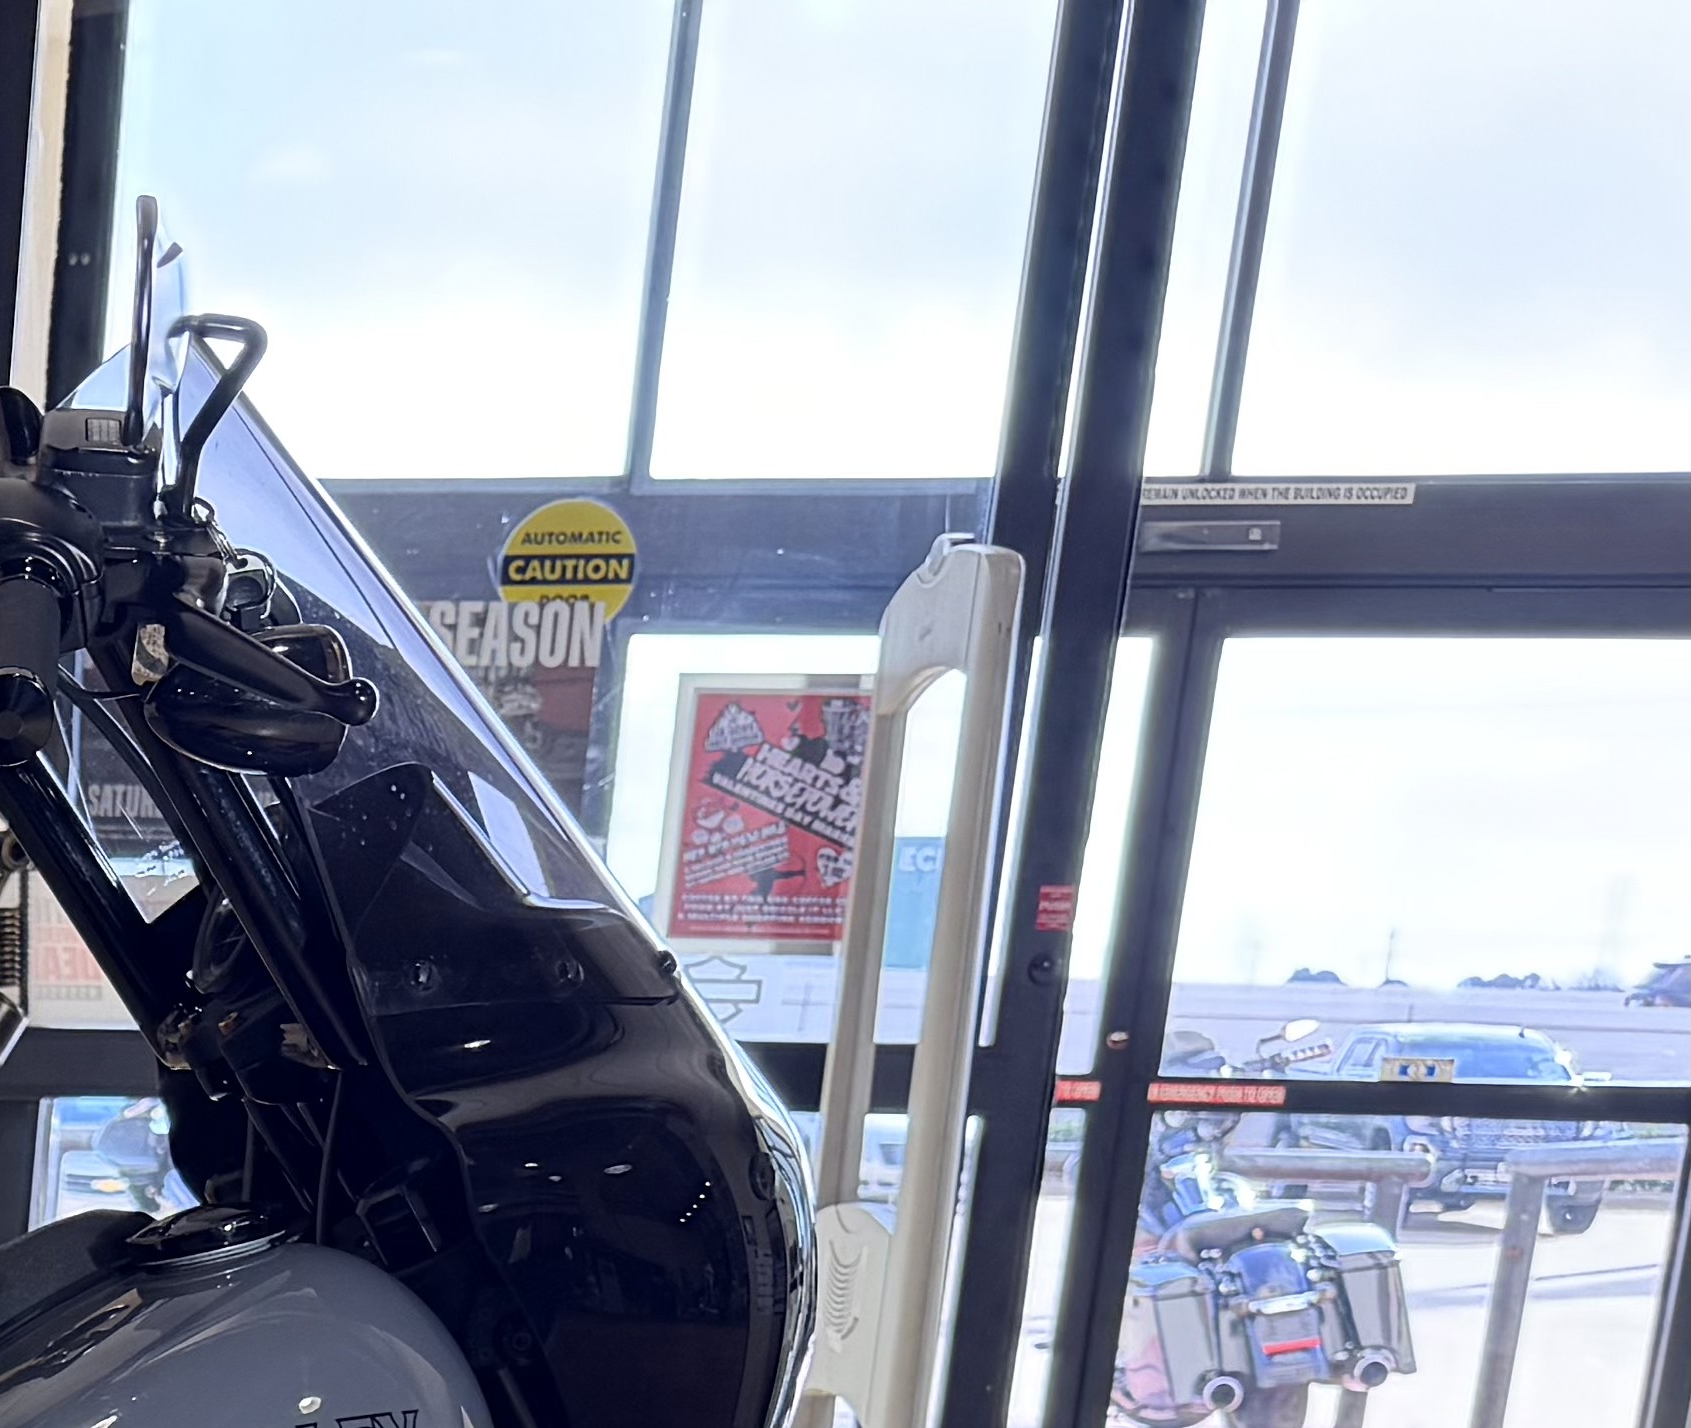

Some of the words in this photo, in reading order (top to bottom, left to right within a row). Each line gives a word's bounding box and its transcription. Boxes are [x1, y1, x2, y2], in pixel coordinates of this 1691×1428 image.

[521, 530, 623, 546] AUTOMATIC
[508, 558, 631, 581] CAUTION
[429, 600, 607, 668] SEASON
